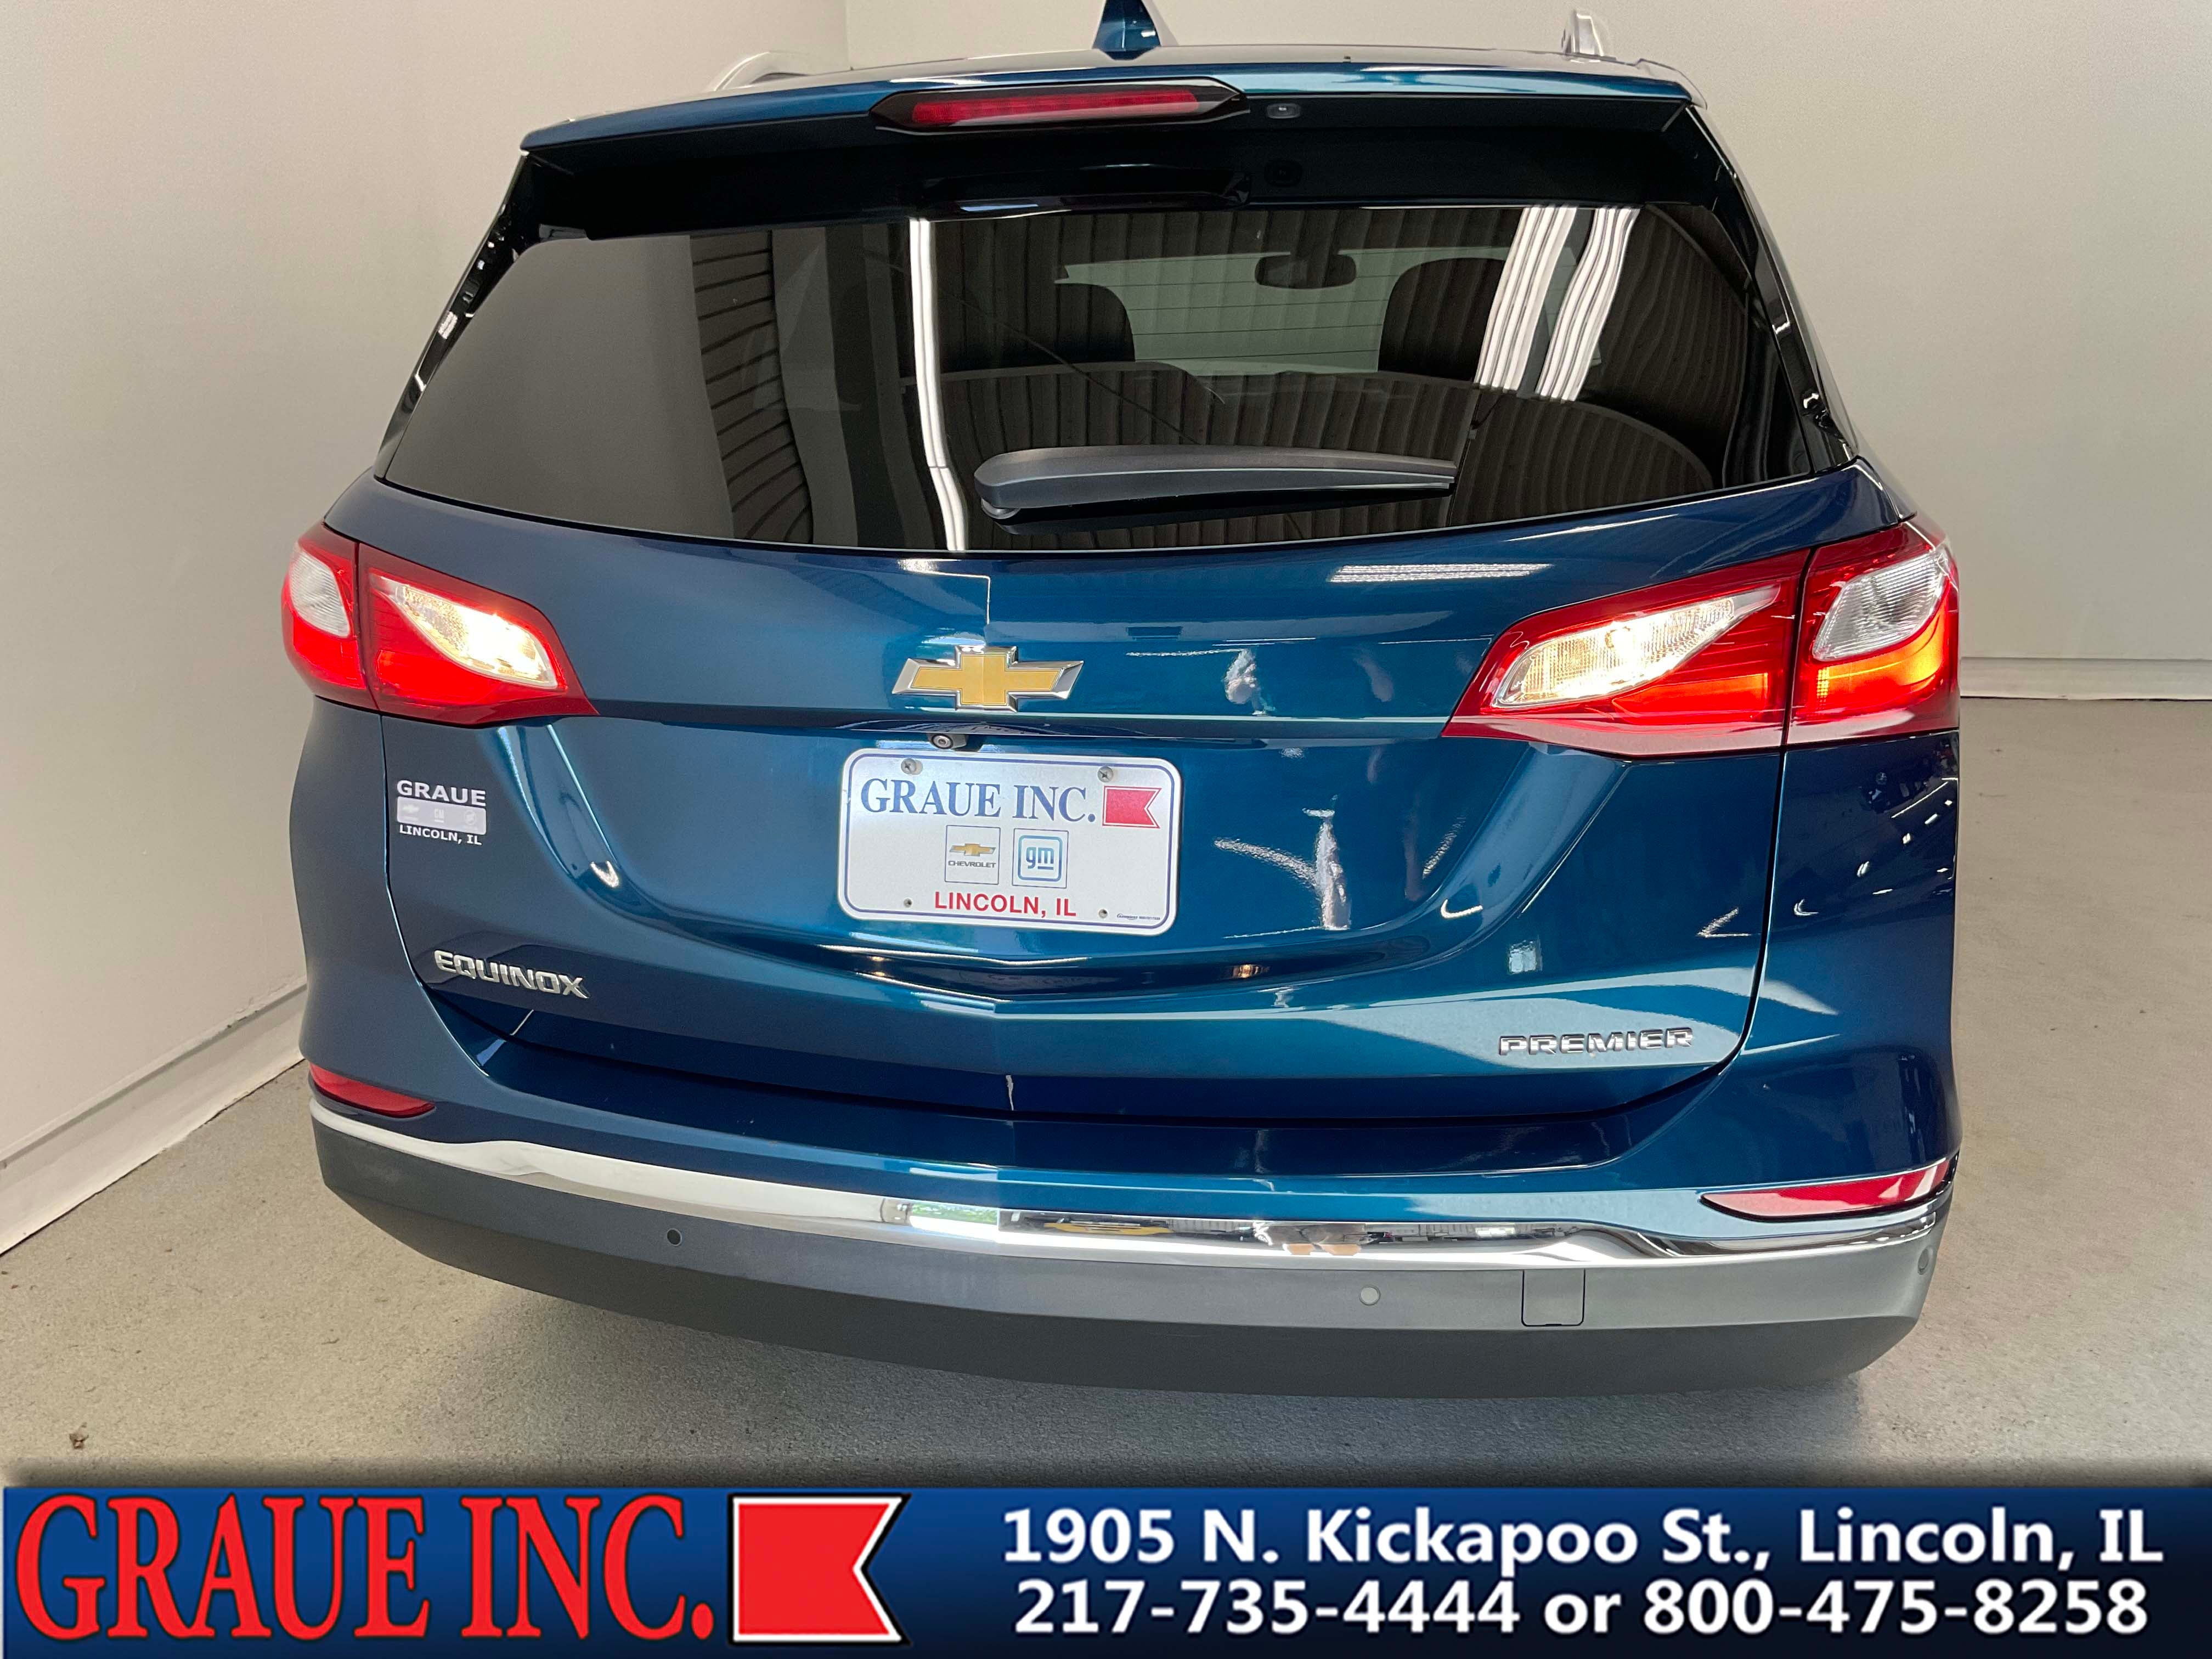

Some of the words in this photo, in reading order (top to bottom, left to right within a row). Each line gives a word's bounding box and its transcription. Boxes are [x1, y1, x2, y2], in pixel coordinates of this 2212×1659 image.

[397, 780, 486, 806] GRAUE
[861, 778, 1001, 817] GRAUE
[1012, 785, 1096, 823] INC.
[399, 824, 462, 844] LINCOLN,
[466, 834, 482, 845] IL
[948, 860, 996, 868] CHEVROLET
[1026, 847, 1054, 870] gm
[935, 891, 1046, 918] LINCOLN,
[1056, 898, 1076, 917] IL
[434, 950, 589, 999] EQUINOX
[1498, 1027, 1693, 1056] PREMIER
